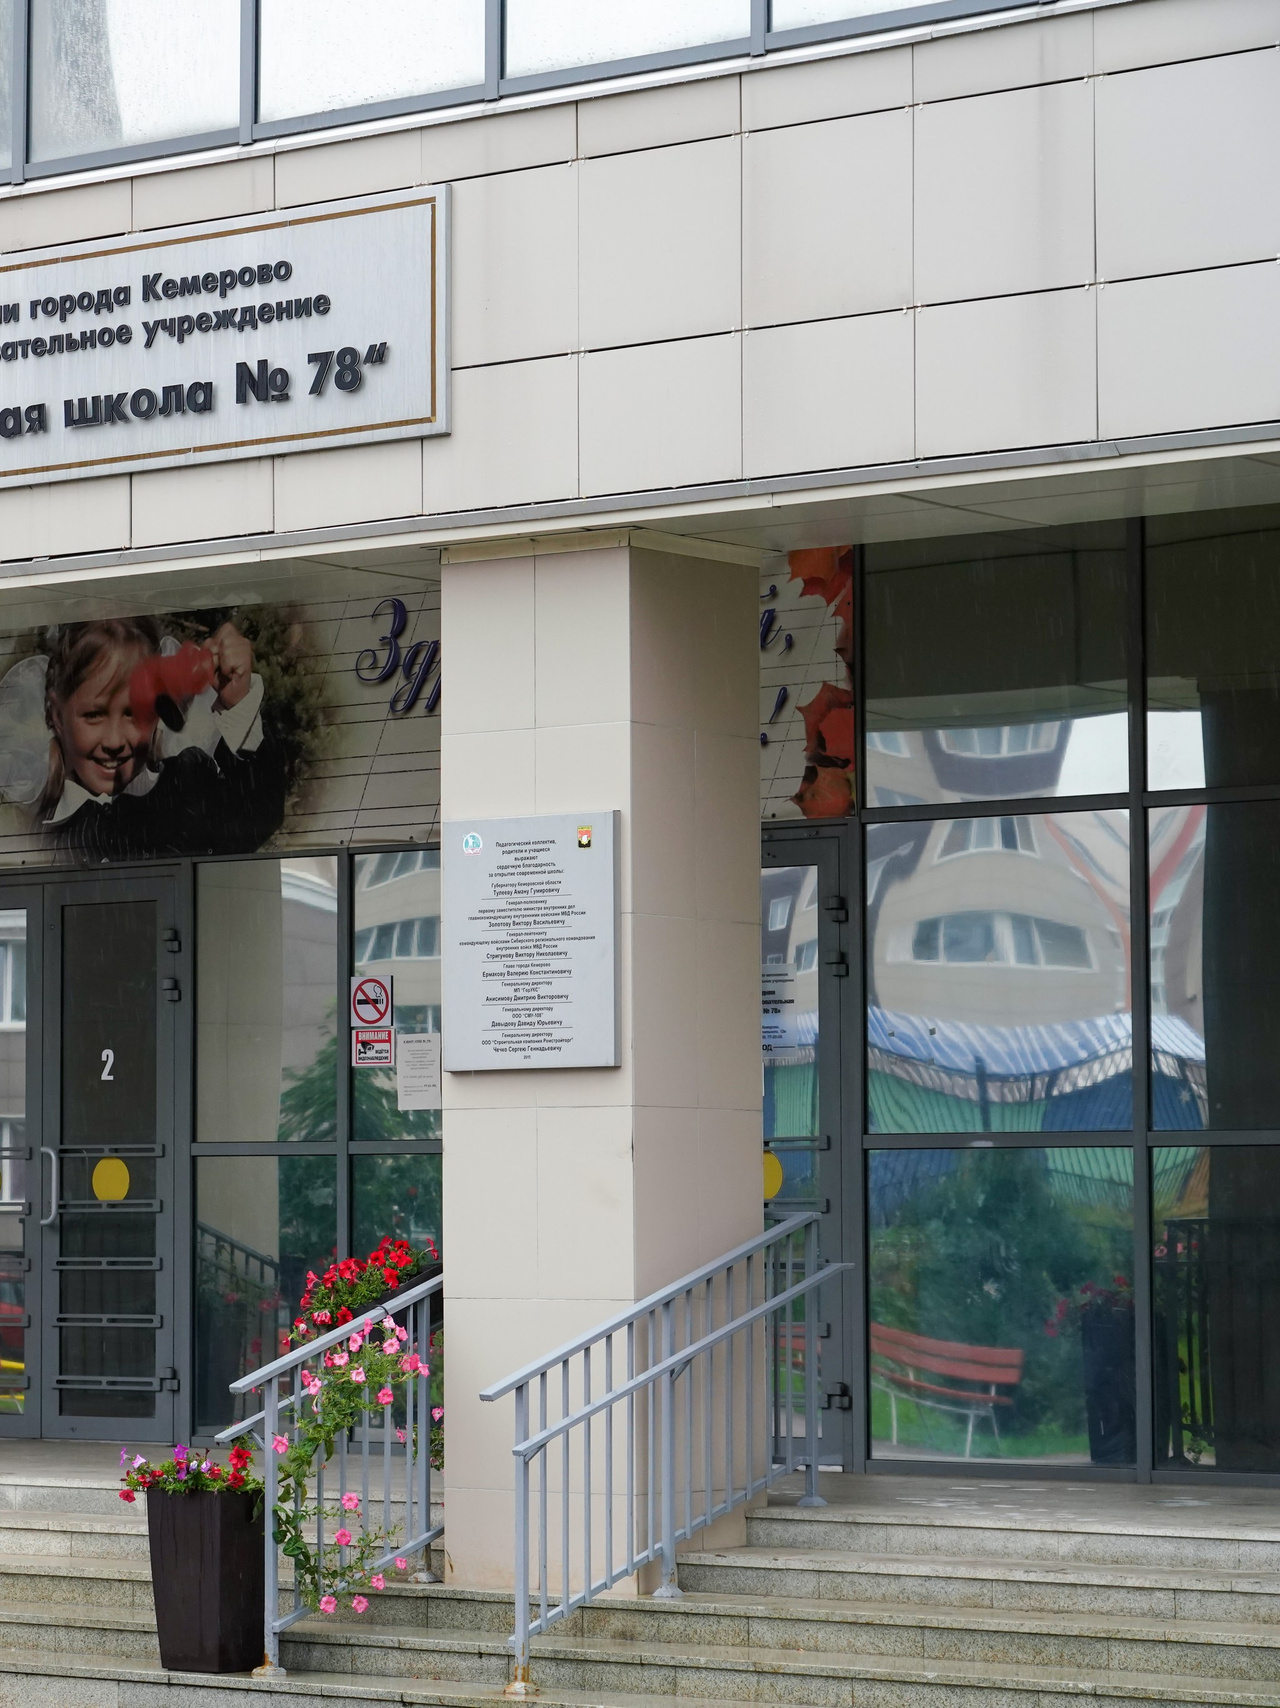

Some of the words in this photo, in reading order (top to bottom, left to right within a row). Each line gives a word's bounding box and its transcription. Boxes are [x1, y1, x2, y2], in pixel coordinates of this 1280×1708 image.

[29, 283, 131, 322] города
[141, 260, 292, 302] Кемерово
[142, 294, 331, 347] учреждение
[63, 380, 213, 428] школа
[235, 359, 290, 402] №
[358, 1031, 389, 1040] ВНИМАНИЕ
[100, 1048, 114, 1081] 2
